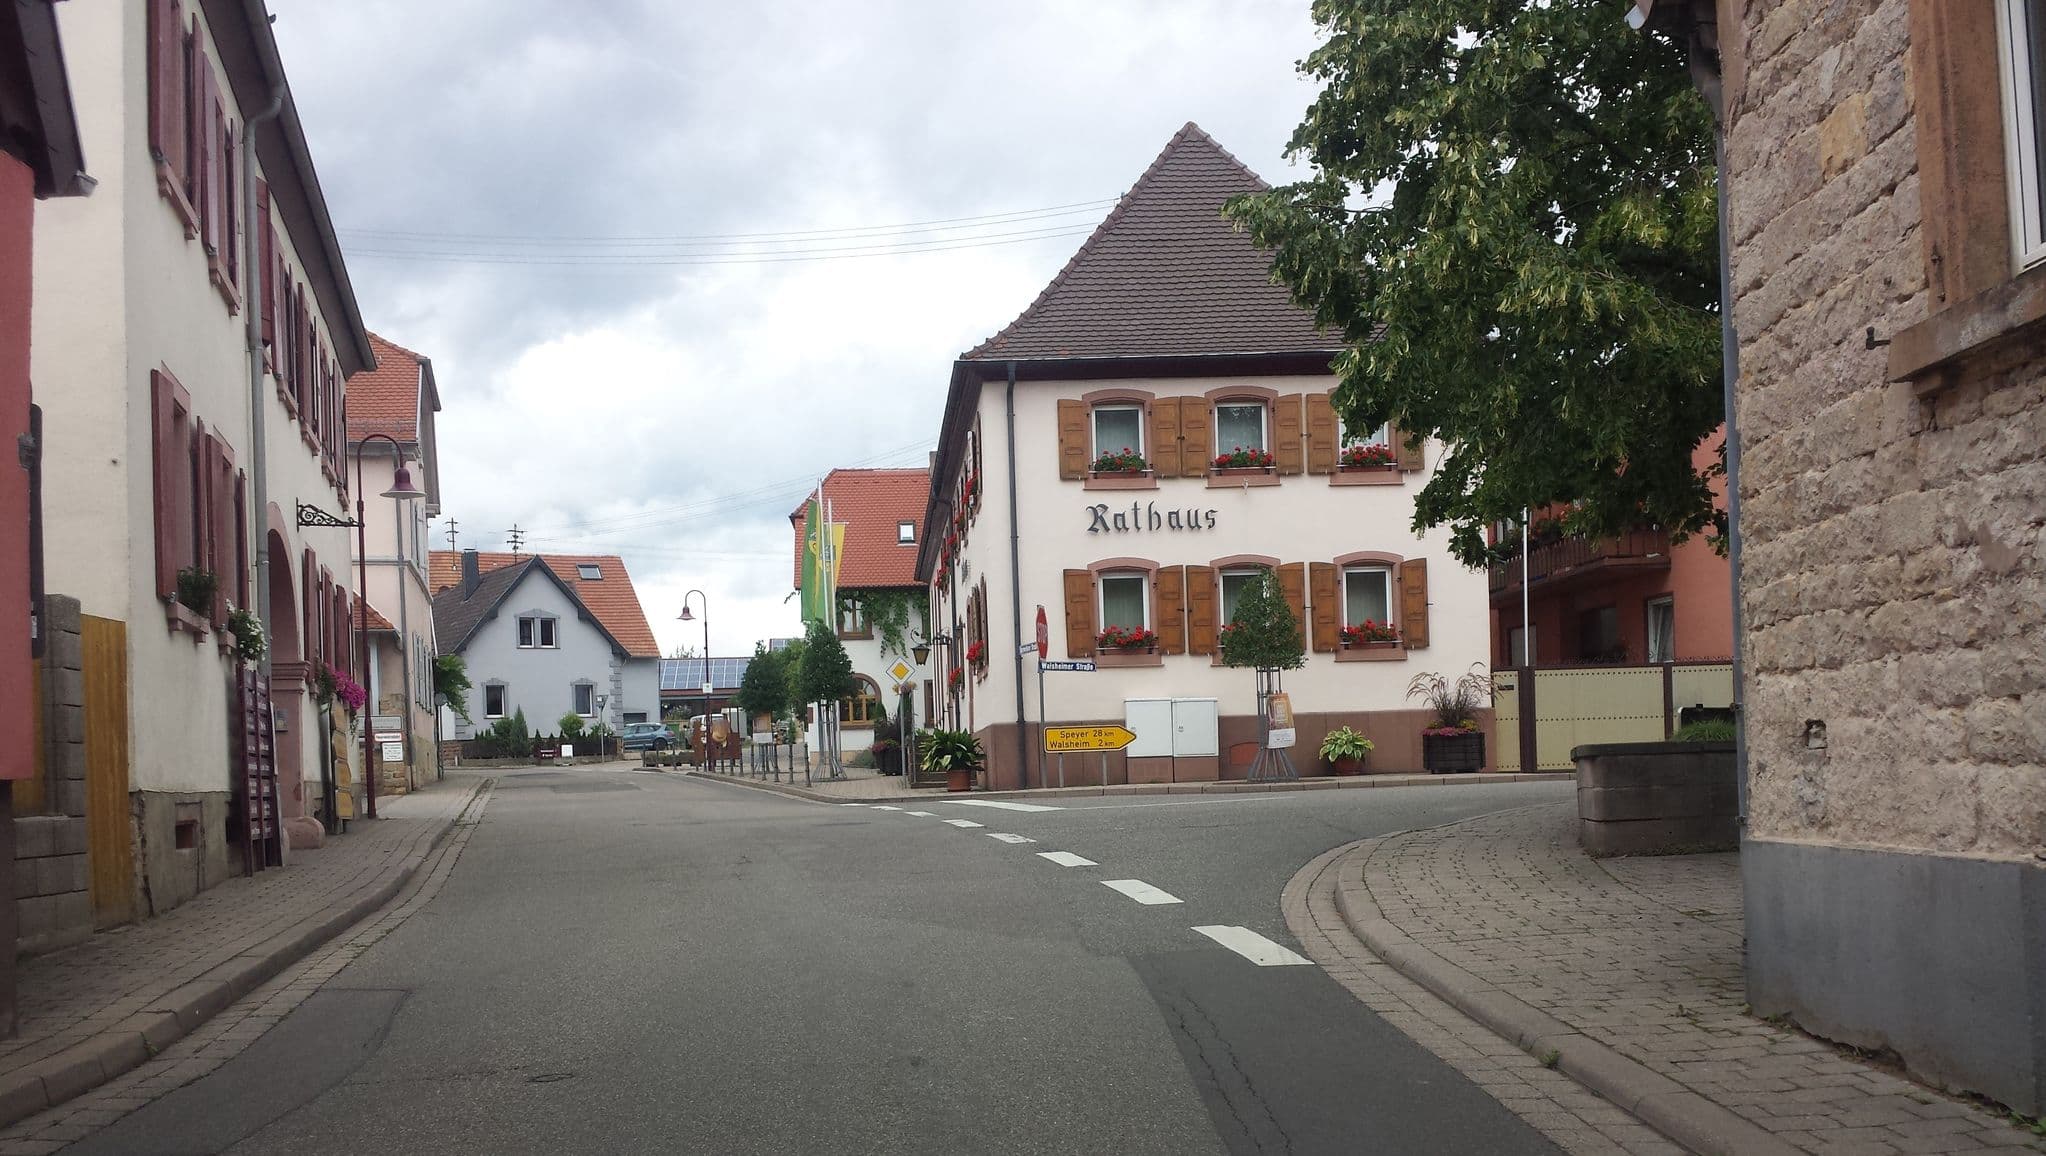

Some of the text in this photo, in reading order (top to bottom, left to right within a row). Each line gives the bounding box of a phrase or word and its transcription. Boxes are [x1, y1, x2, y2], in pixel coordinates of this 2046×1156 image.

[1086, 500, 1218, 533] Rathaus
[1041, 662, 1074, 671] Walsheimer
[1060, 731, 1089, 739] Speyer
[1093, 730, 1103, 738] 28
[1050, 740, 1090, 749] Walsheim
